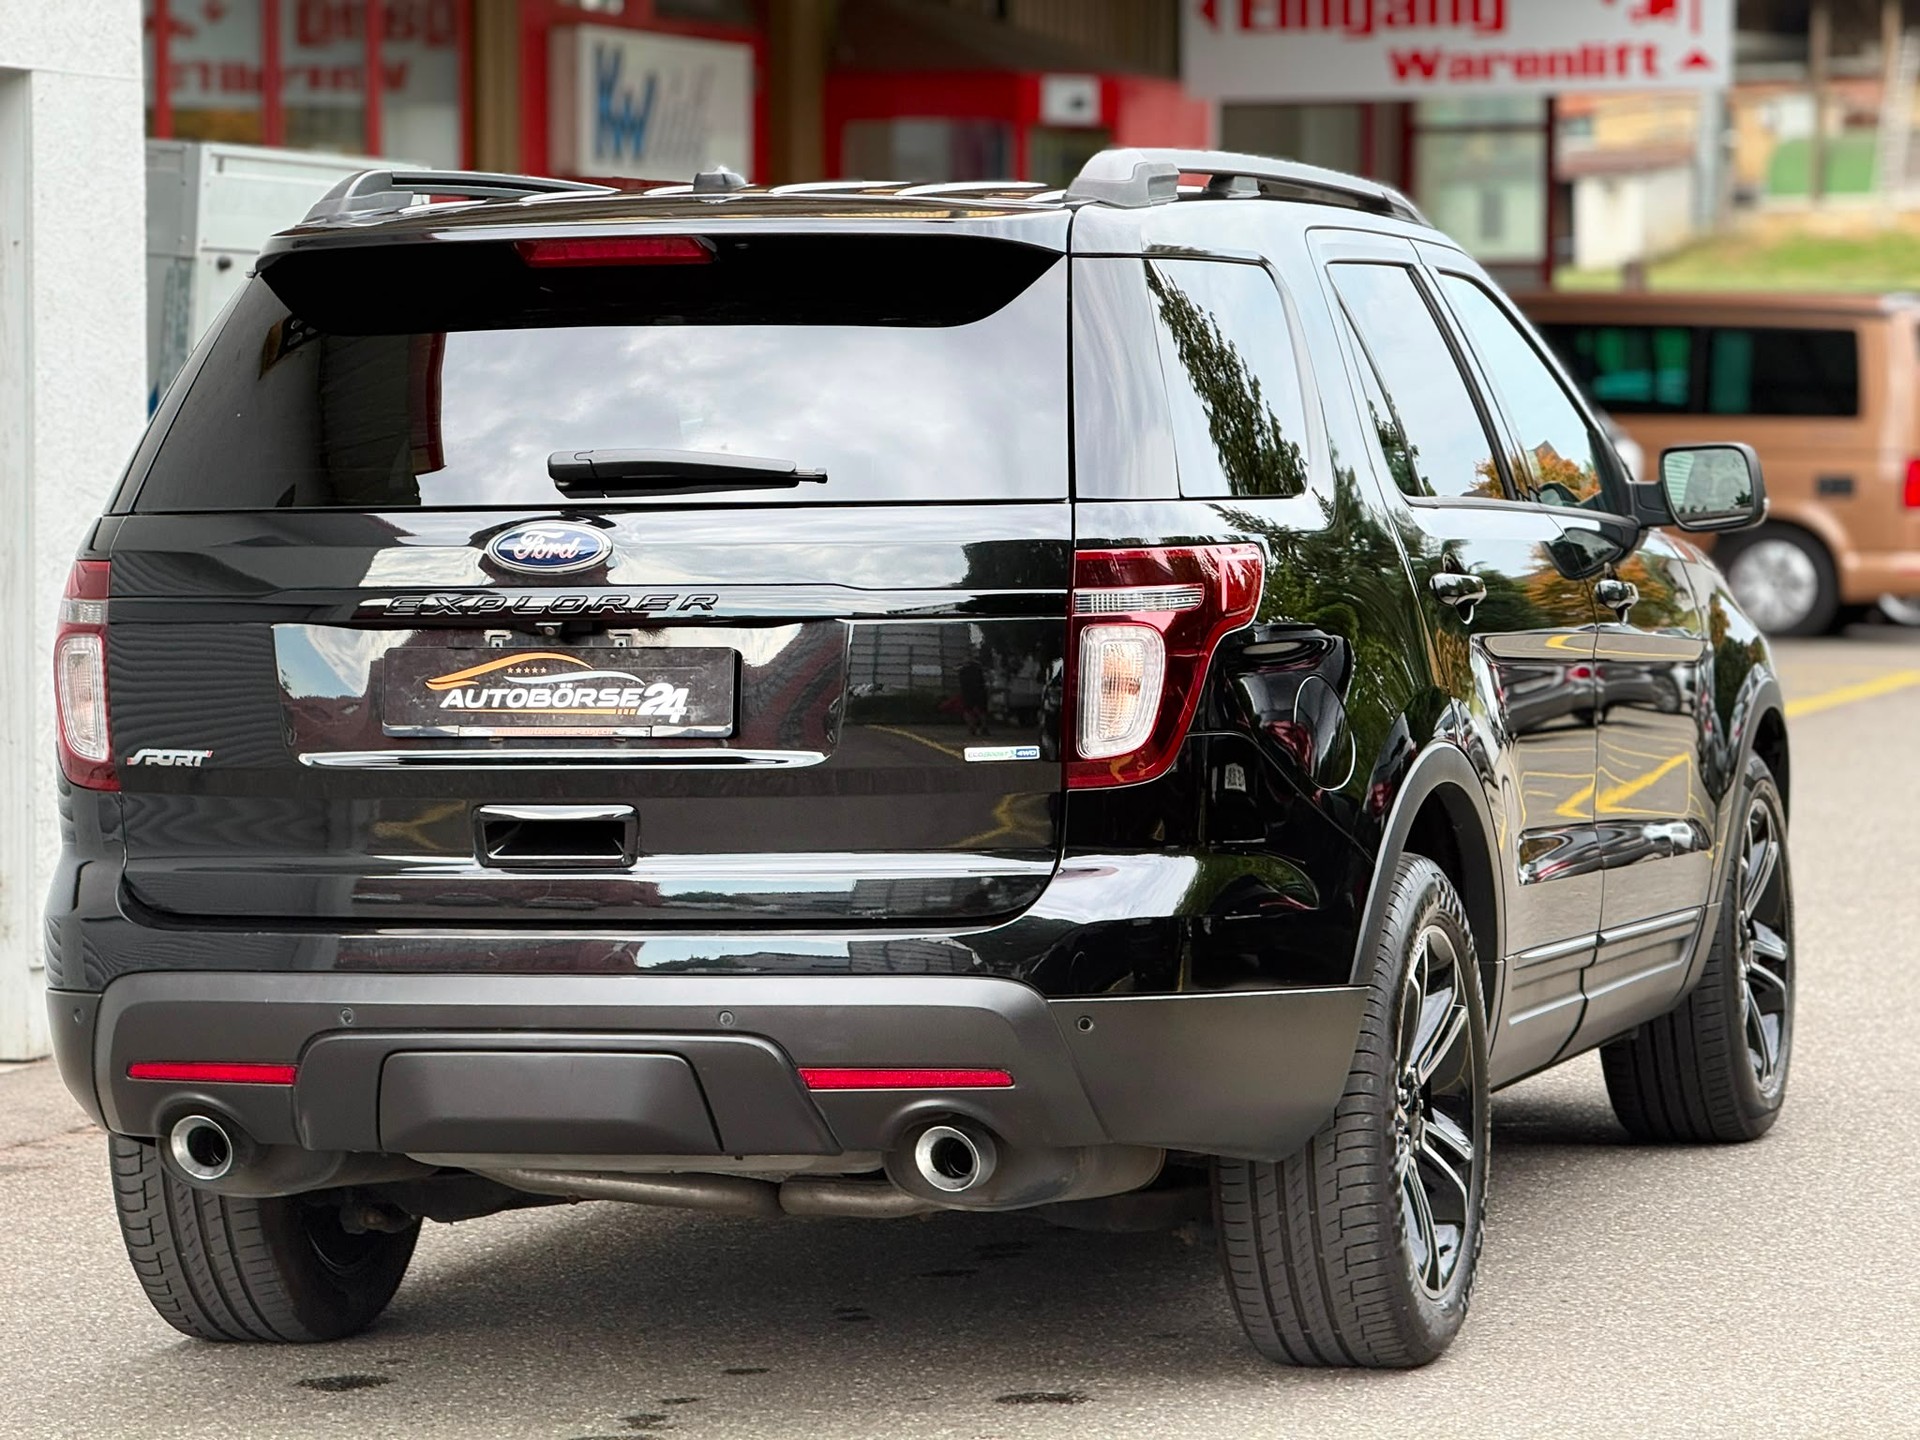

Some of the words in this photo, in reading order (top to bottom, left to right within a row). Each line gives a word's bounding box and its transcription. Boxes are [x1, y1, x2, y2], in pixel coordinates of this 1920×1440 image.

[1389, 44, 1662, 83] Warenlift
[513, 530, 580, 560] Ford
[383, 593, 719, 617] EXPLORER
[126, 748, 214, 767] SPORT
[1017, 750, 1037, 758] 4WD
